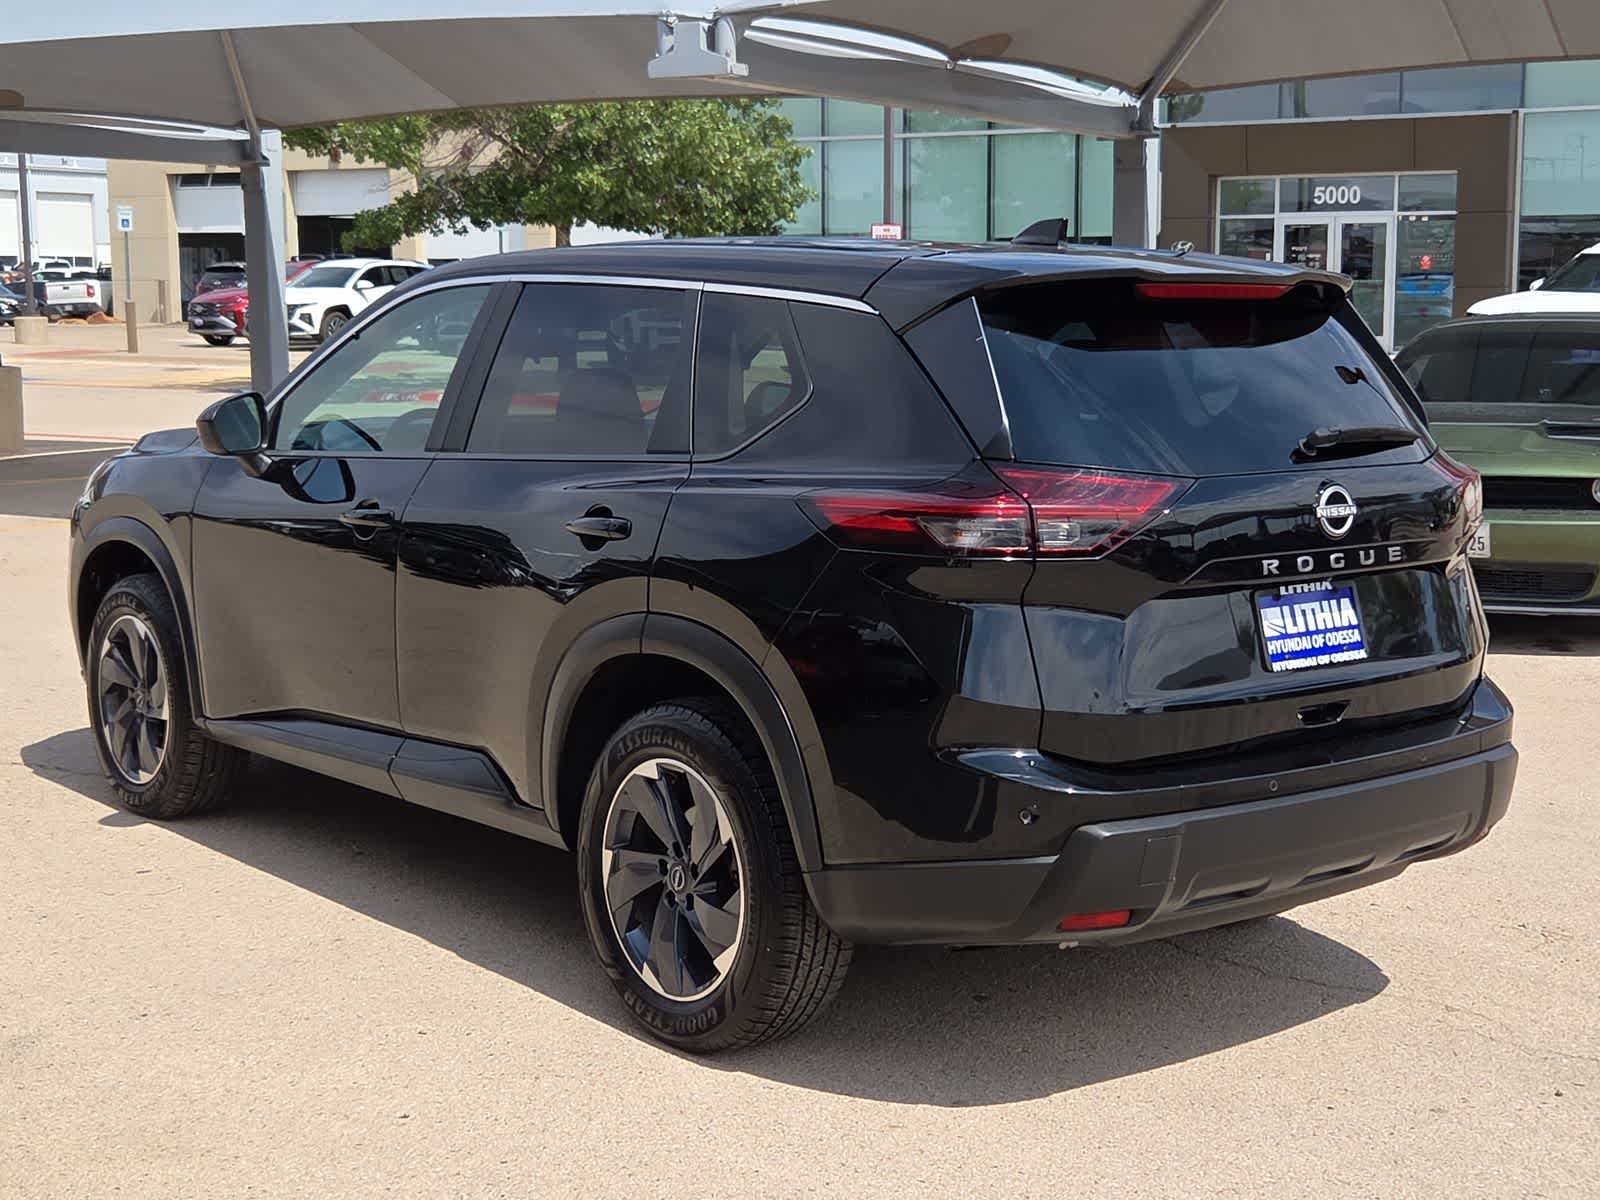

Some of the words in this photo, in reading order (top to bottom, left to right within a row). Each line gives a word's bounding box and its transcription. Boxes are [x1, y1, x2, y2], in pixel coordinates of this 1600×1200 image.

[1313, 185, 1361, 205] 5000
[1317, 505, 1357, 518] NISSAN
[1469, 536, 1485, 551] 25
[1262, 547, 1403, 576] ROGUE
[1279, 578, 1334, 596] LITHIA
[1281, 598, 1359, 634] LITHIA
[1267, 635, 1313, 655] HYUNDAI
[1312, 632, 1325, 649] OF
[1326, 629, 1361, 647] ODESSA
